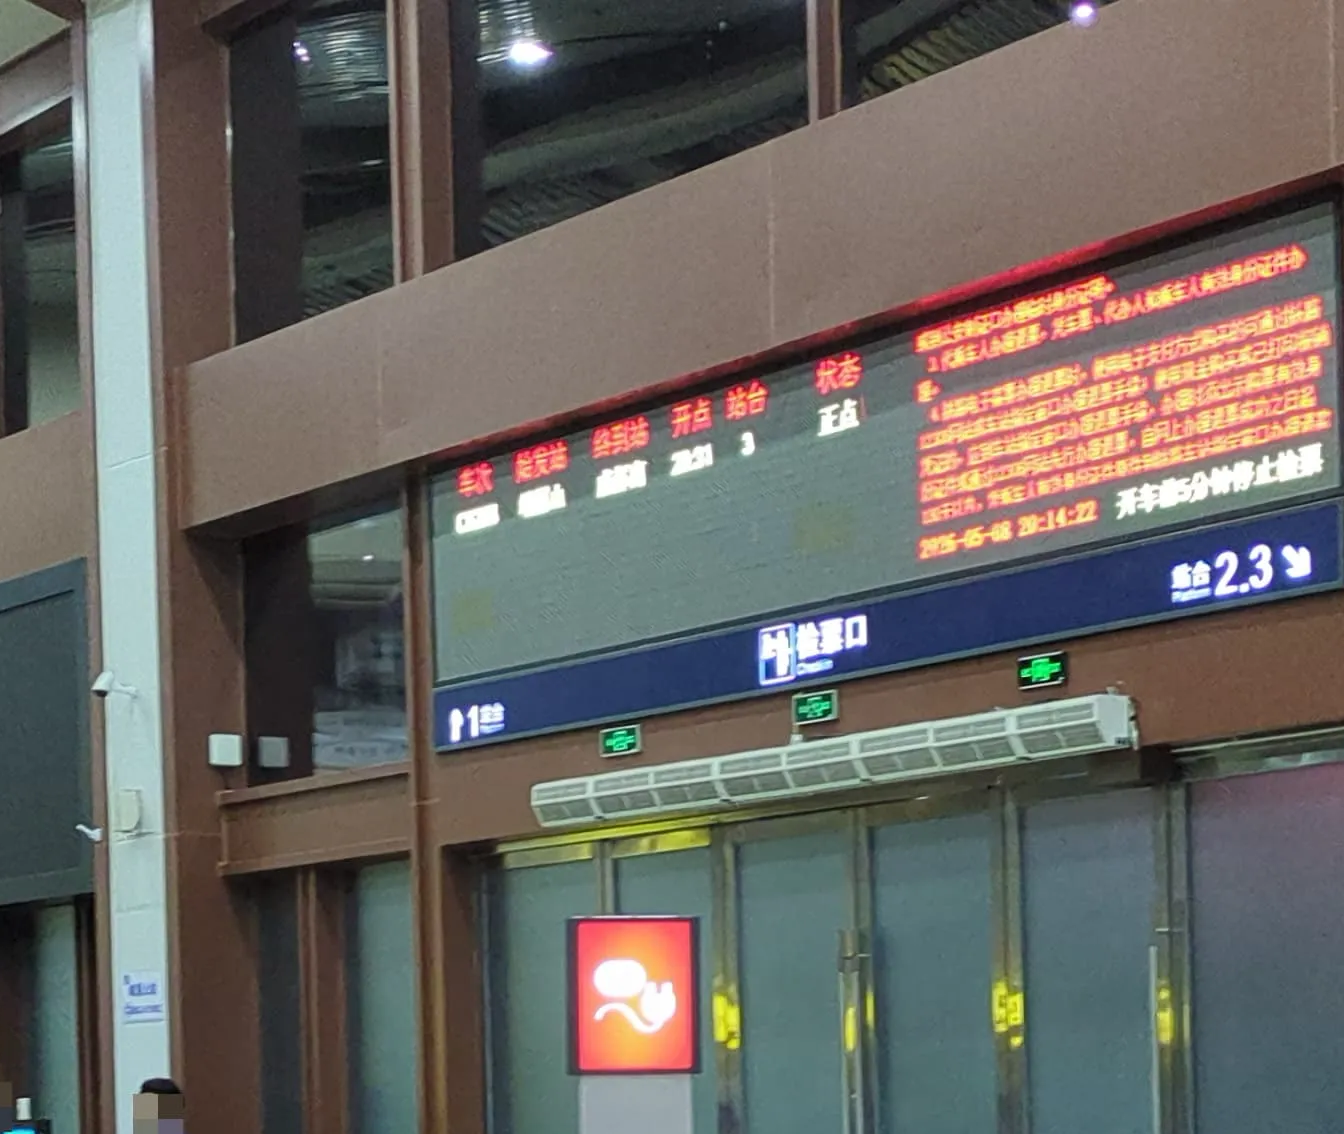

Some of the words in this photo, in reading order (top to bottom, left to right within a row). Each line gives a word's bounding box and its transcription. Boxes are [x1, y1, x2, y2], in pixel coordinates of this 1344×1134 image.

[669, 397, 713, 439] 开点
[724, 379, 768, 421] 站台
[814, 351, 862, 395] 状态
[740, 432, 756, 457] 3
[817, 398, 860, 436] 正点
[1213, 543, 1274, 597] 2.3
[796, 614, 868, 661] 检票口
